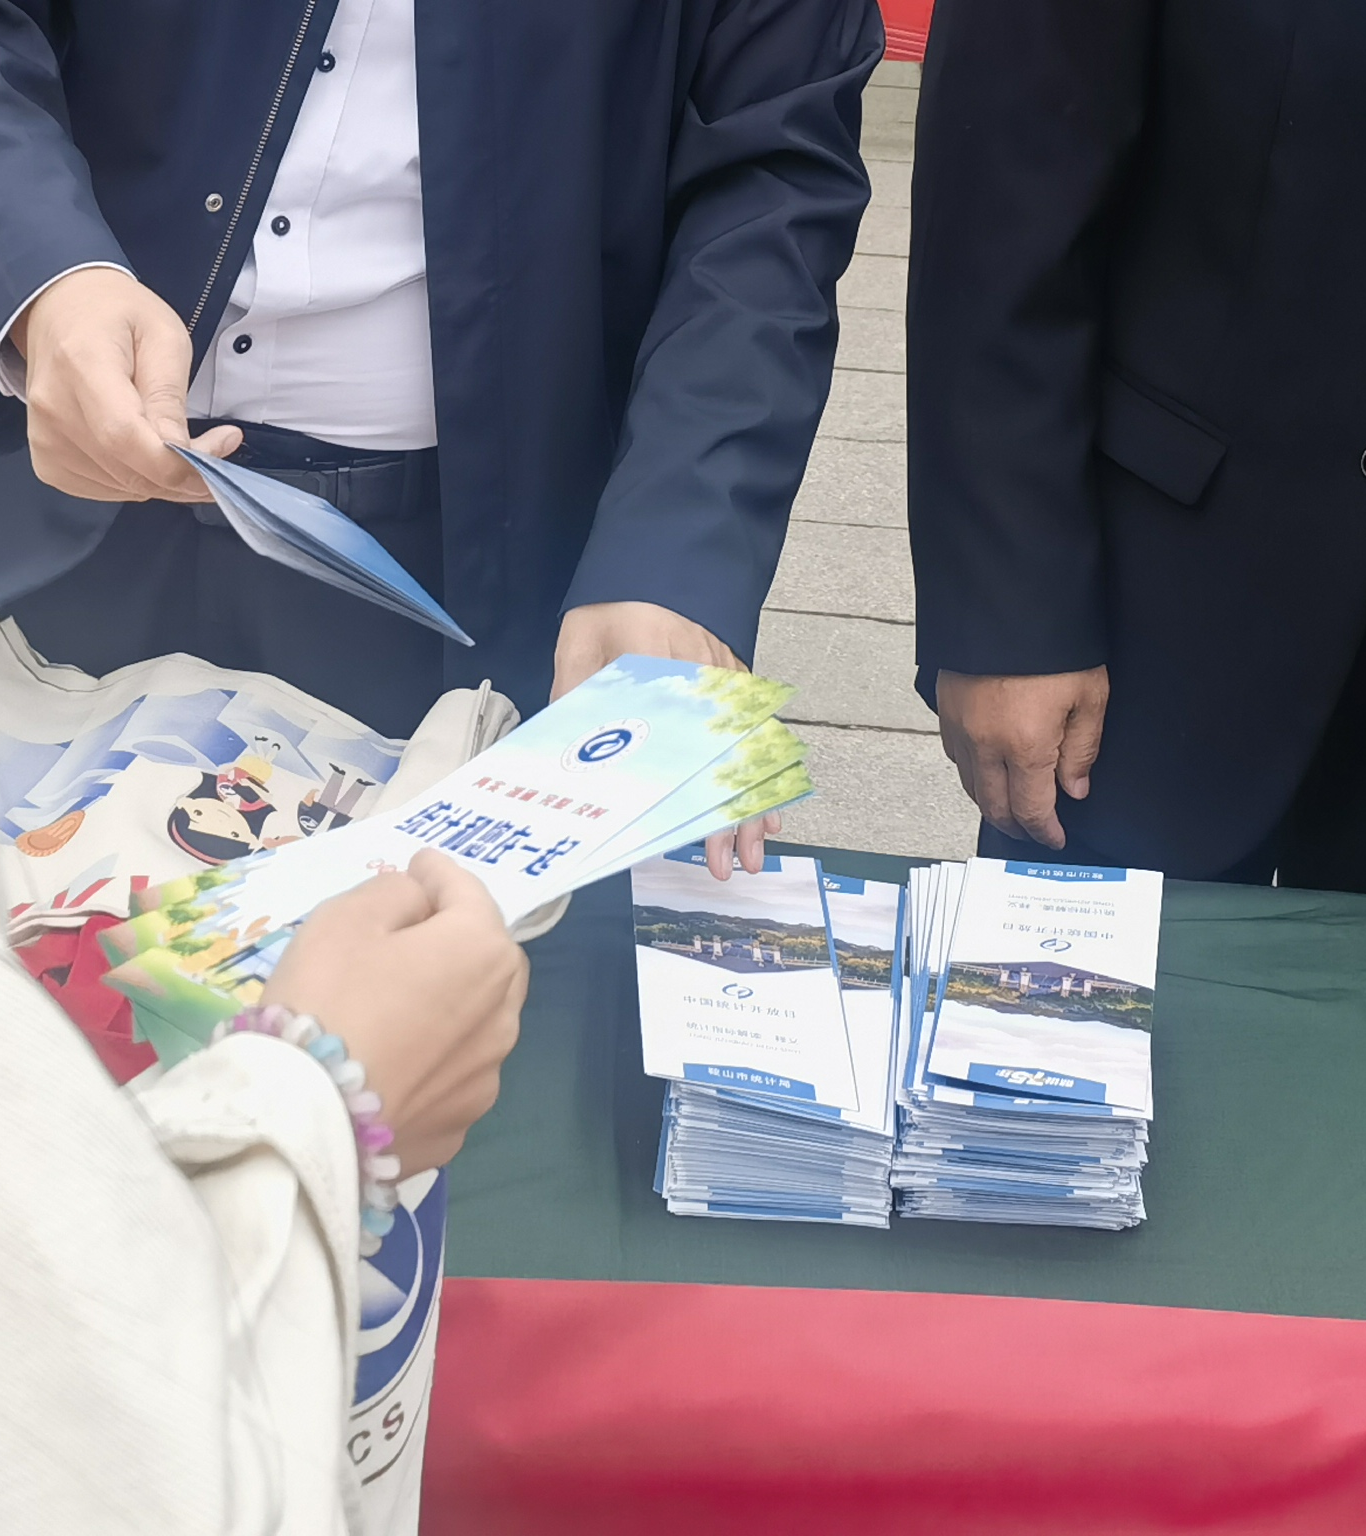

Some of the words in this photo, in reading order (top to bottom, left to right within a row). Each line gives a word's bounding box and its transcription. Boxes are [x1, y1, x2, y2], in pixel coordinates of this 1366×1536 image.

[394, 800, 581, 876] 统计和您在一起
[708, 1066, 791, 1089] 鞍山市统计局
